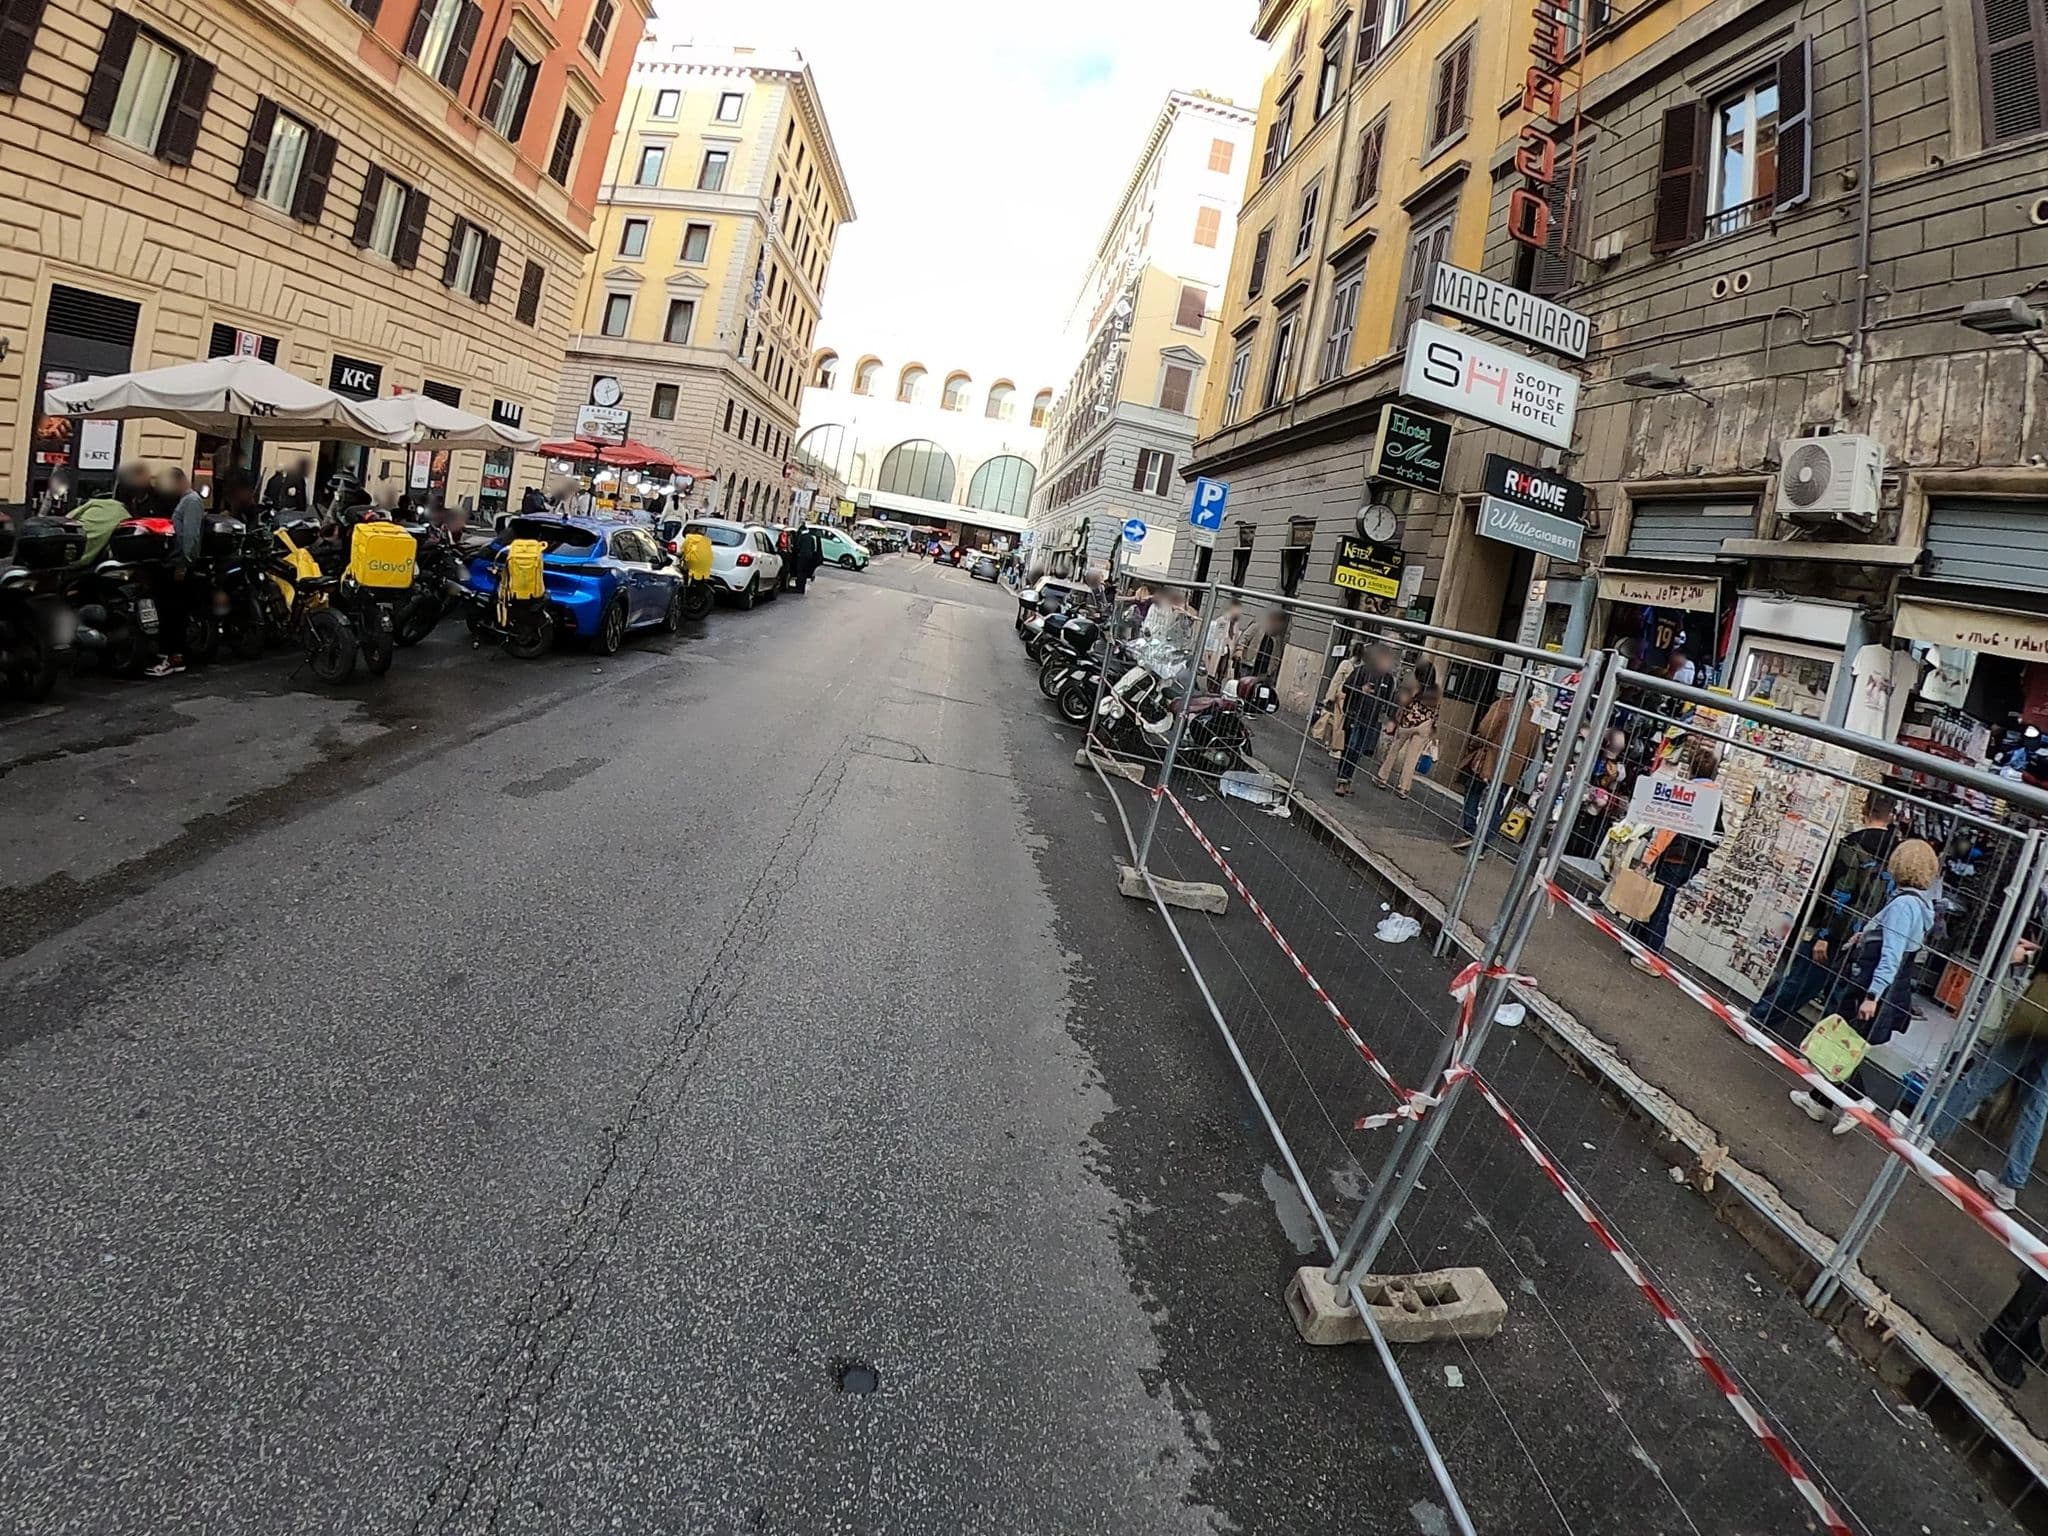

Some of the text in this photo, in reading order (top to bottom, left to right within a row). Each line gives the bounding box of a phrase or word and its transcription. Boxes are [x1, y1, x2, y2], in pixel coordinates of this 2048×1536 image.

[1436, 267, 1586, 353] MARECHIARO
[1101, 320, 1124, 404] GIOBERTI
[1424, 342, 1508, 406] SH
[340, 367, 375, 391] KFC
[1515, 372, 1562, 398] SCOTT
[66, 399, 95, 413] KFC
[251, 402, 279, 417] KFC
[1513, 386, 1565, 415] HOUSE
[1511, 401, 1557, 428] HOTEL
[1391, 413, 1431, 442] Hotel
[91, 451, 110, 460] KFC
[1201, 484, 1223, 507] P
[1505, 469, 1568, 507] RHOME
[368, 559, 406, 573] Glovo
[1338, 572, 1367, 588] ORO
[1656, 625, 1672, 649] 19
[1654, 782, 1696, 803] BigMat
